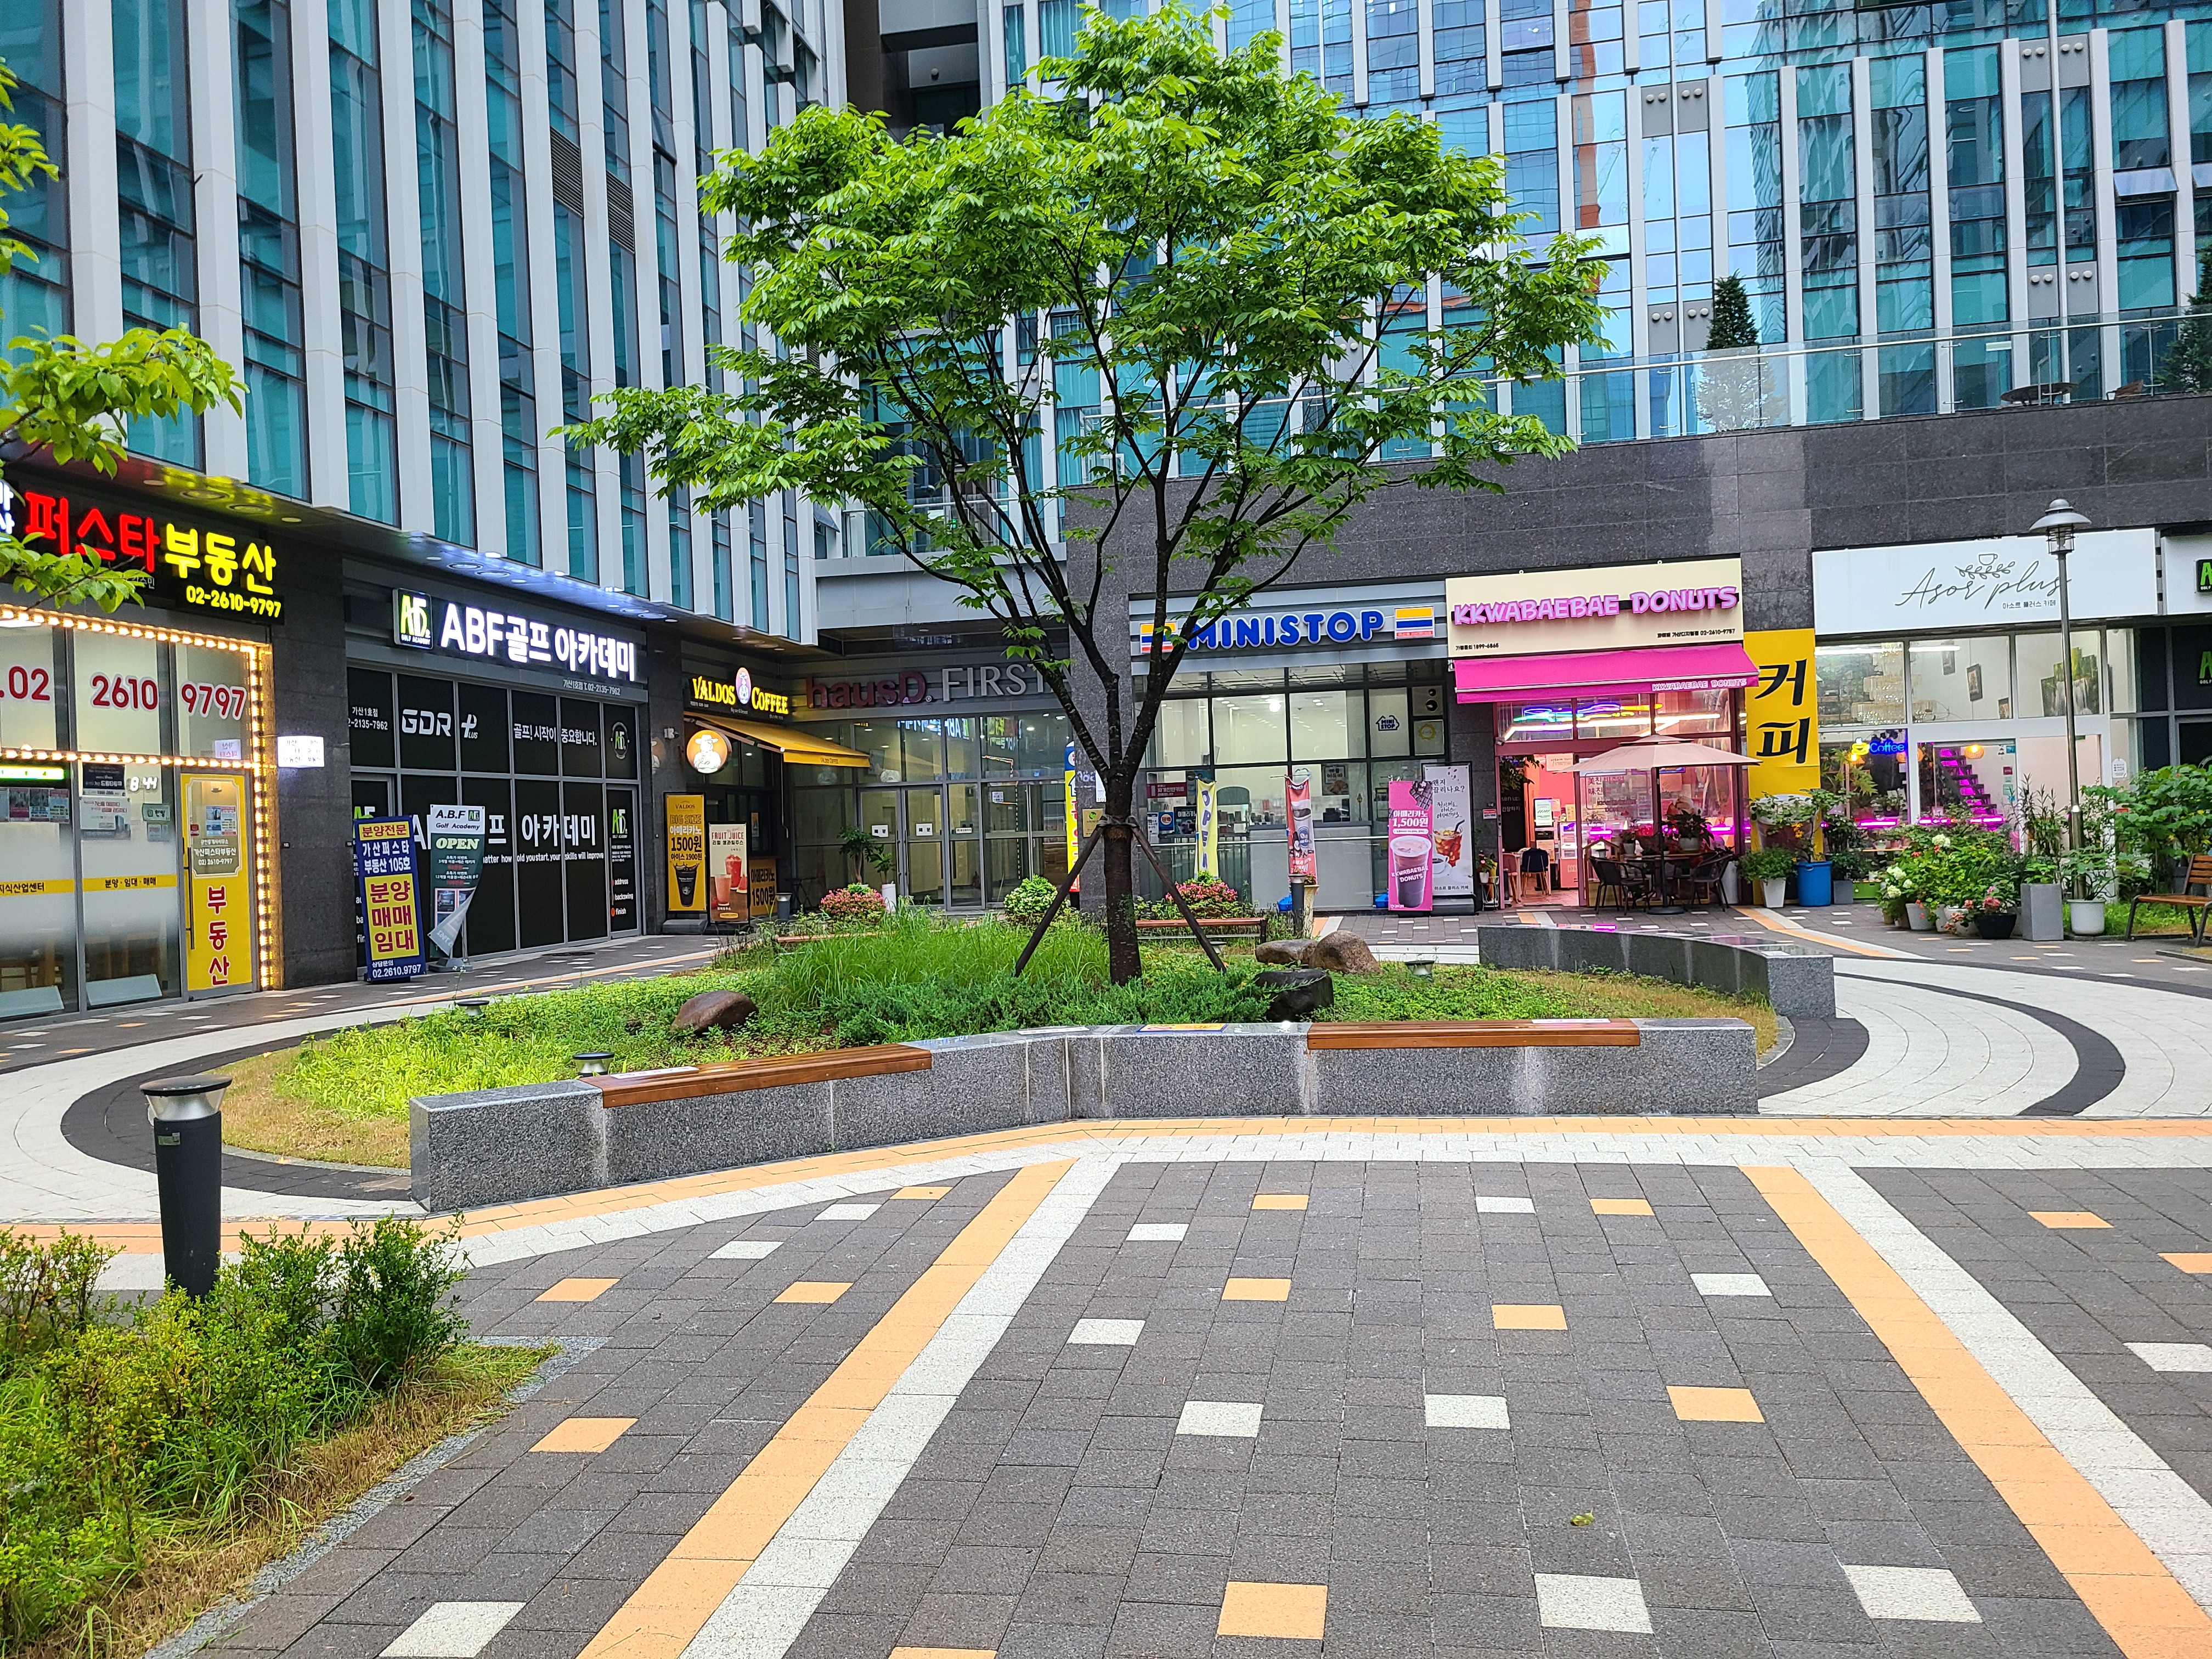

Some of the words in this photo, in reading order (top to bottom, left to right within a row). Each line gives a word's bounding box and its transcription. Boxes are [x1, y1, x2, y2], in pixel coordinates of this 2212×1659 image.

[25, 492, 160, 572] 퍼스타
[165, 523, 276, 595] 부동산
[1984, 561, 2072, 609] plus
[186, 585, 281, 618] 02-2610-9797
[1454, 595, 1620, 625] KKWABAEBAE
[1629, 586, 1737, 614] DONUTS
[1189, 610, 1385, 650] MINISTOP
[441, 602, 551, 663] ABF골프
[555, 628, 635, 682] 아카데미
[692, 676, 736, 705] VALDOS
[752, 687, 788, 714] COFFEE
[1652, 681, 1708, 691] KKWABAEBAE
[1711, 679, 1747, 688] DONUTS
[92, 675, 158, 710] 2610
[181, 684, 245, 718] 9797
[352, 707, 379, 717] 가산1호점
[1754, 659, 1809, 764] 커피
[402, 709, 452, 737] GDR
[514, 723, 533, 741] 골프!
[534, 725, 556, 742] 시작이
[561, 728, 597, 746] 중요합니다.
[1870, 741, 1905, 752] Coffee
[436, 810, 466, 819] A.B.F
[670, 814, 683, 824] BIG
[685, 814, 702, 824] SIZE
[1393, 817, 1429, 827] 1,500원
[362, 824, 407, 838] 분양전문
[522, 814, 595, 847] 아카데미
[362, 840, 409, 857] 가산퍼스타
[436, 838, 480, 849] OPEN
[671, 835, 702, 853] 1500원
[364, 857, 387, 874] 부동산
[388, 856, 411, 872] 105호
[501, 854, 512, 863] how
[516, 854, 525, 862] old
[1391, 866, 1429, 877] KKWABAEBAE
[1400, 873, 1423, 882] DONUTS
[105, 879, 119, 888] 분양
[125, 878, 138, 887] 임대
[143, 877, 156, 886] 매매
[370, 881, 410, 904] 분양
[752, 885, 775, 906] 1500원
[371, 905, 412, 927] 매매
[208, 886, 229, 985] 부동산
[375, 929, 414, 952] 임대
[372, 964, 421, 978] 02.2610.9797
